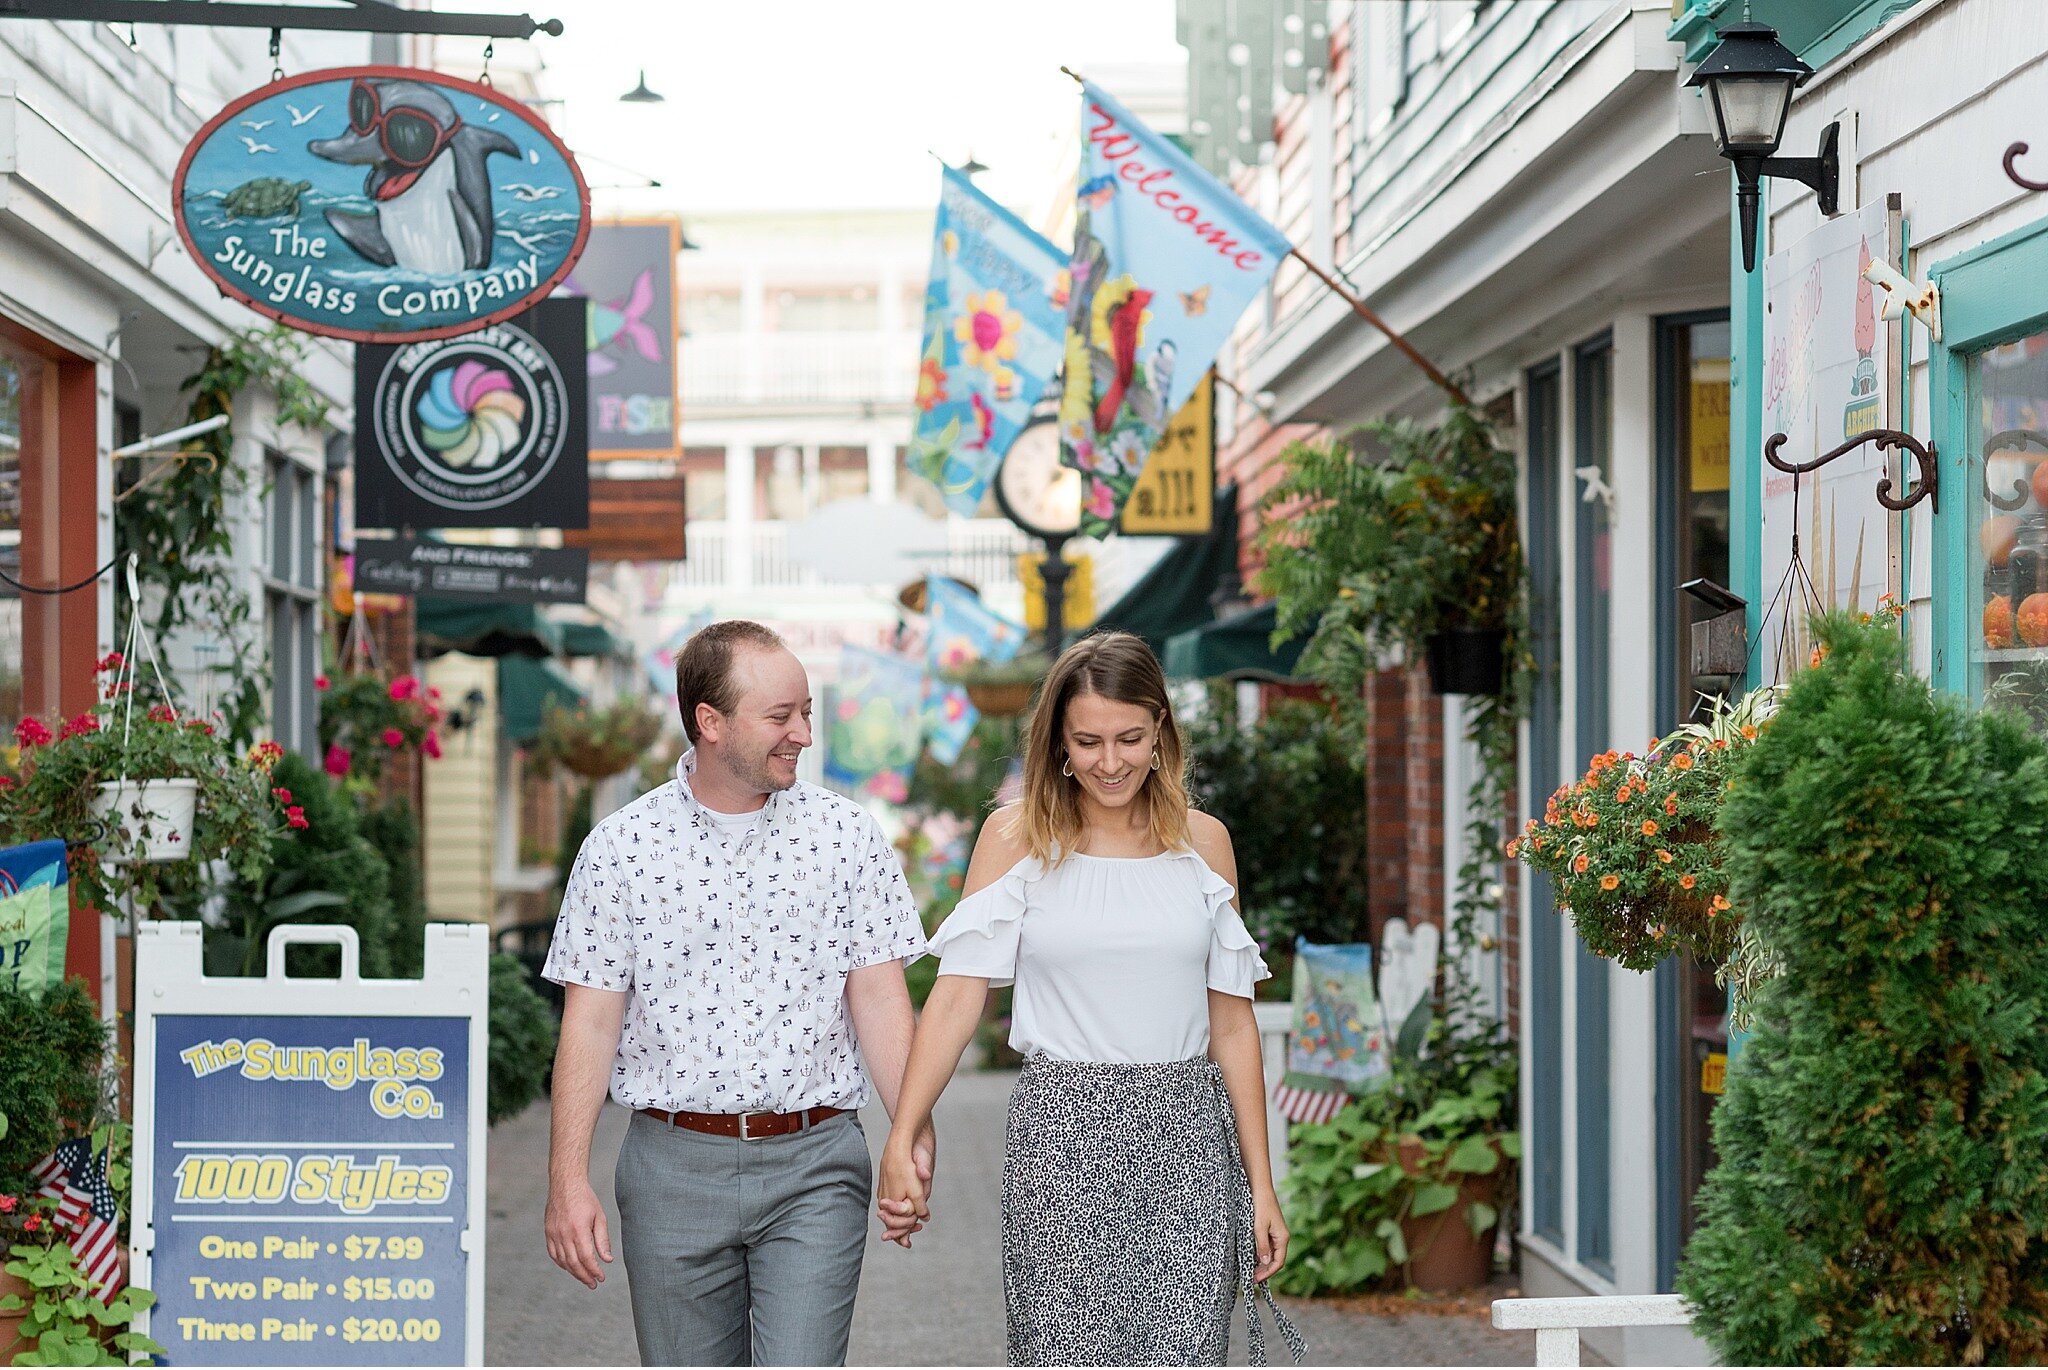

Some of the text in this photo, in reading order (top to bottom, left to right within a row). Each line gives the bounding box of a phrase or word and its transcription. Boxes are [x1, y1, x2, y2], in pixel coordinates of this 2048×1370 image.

[1089, 103, 1262, 272] Welcome
[269, 227, 327, 259] The
[214, 235, 539, 317] Sunglass Company
[598, 394, 671, 434] FISH
[180, 1038, 443, 1090] The Sunglass
[370, 1081, 443, 1119] Co.
[174, 1154, 453, 1213] 1000 Styles
[199, 1234, 424, 1261] One Pair $7.99
[190, 1276, 435, 1303] Two Pair $15.00
[177, 1316, 441, 1344] Three Pair $20.00
